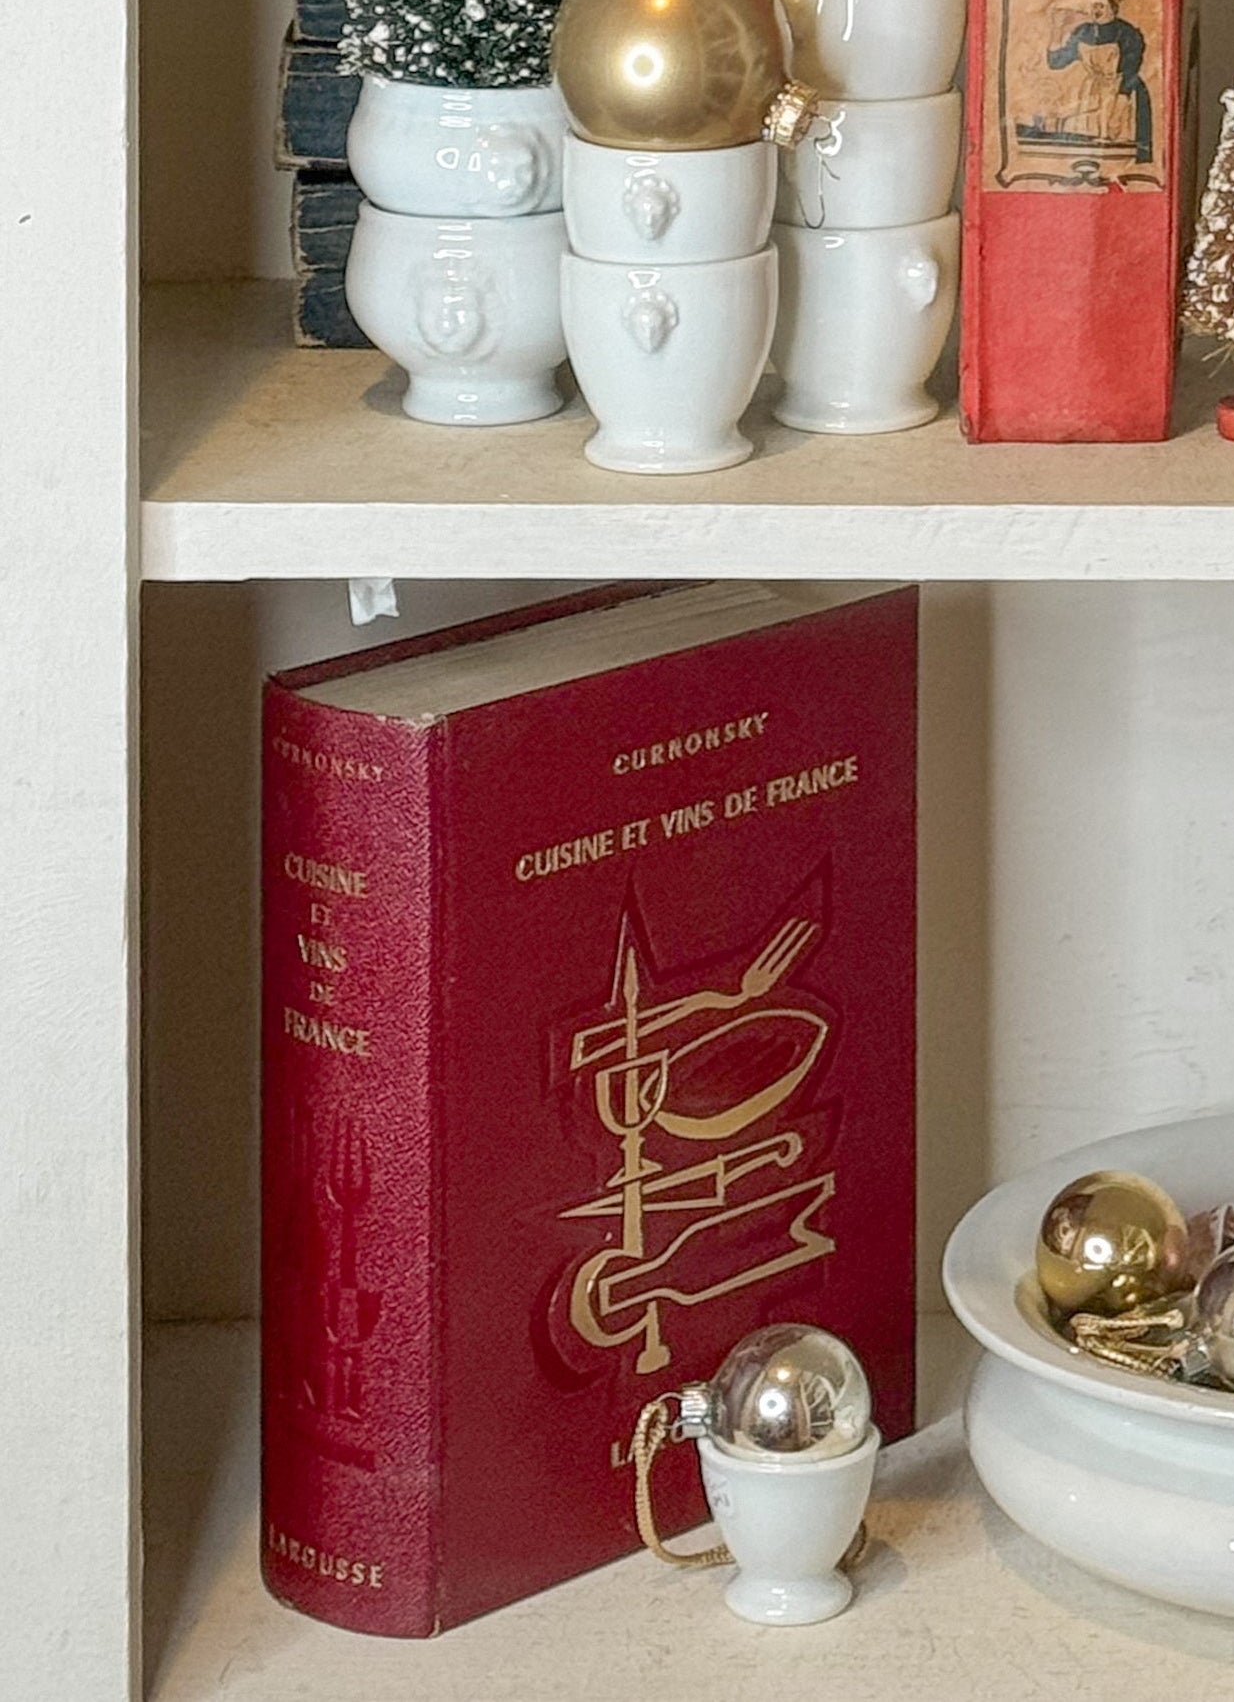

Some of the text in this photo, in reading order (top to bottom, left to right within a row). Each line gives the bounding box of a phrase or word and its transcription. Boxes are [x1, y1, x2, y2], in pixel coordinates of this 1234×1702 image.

[611, 710, 770, 776] CURNONSKY
[514, 755, 860, 883] CUISINE ET VINS DE FRANCE
[284, 850, 368, 898] CUISINE
[310, 902, 333, 927] ET
[297, 933, 348, 974] VINS
[309, 980, 336, 1005] DE
[283, 1006, 372, 1057] FRANCE
